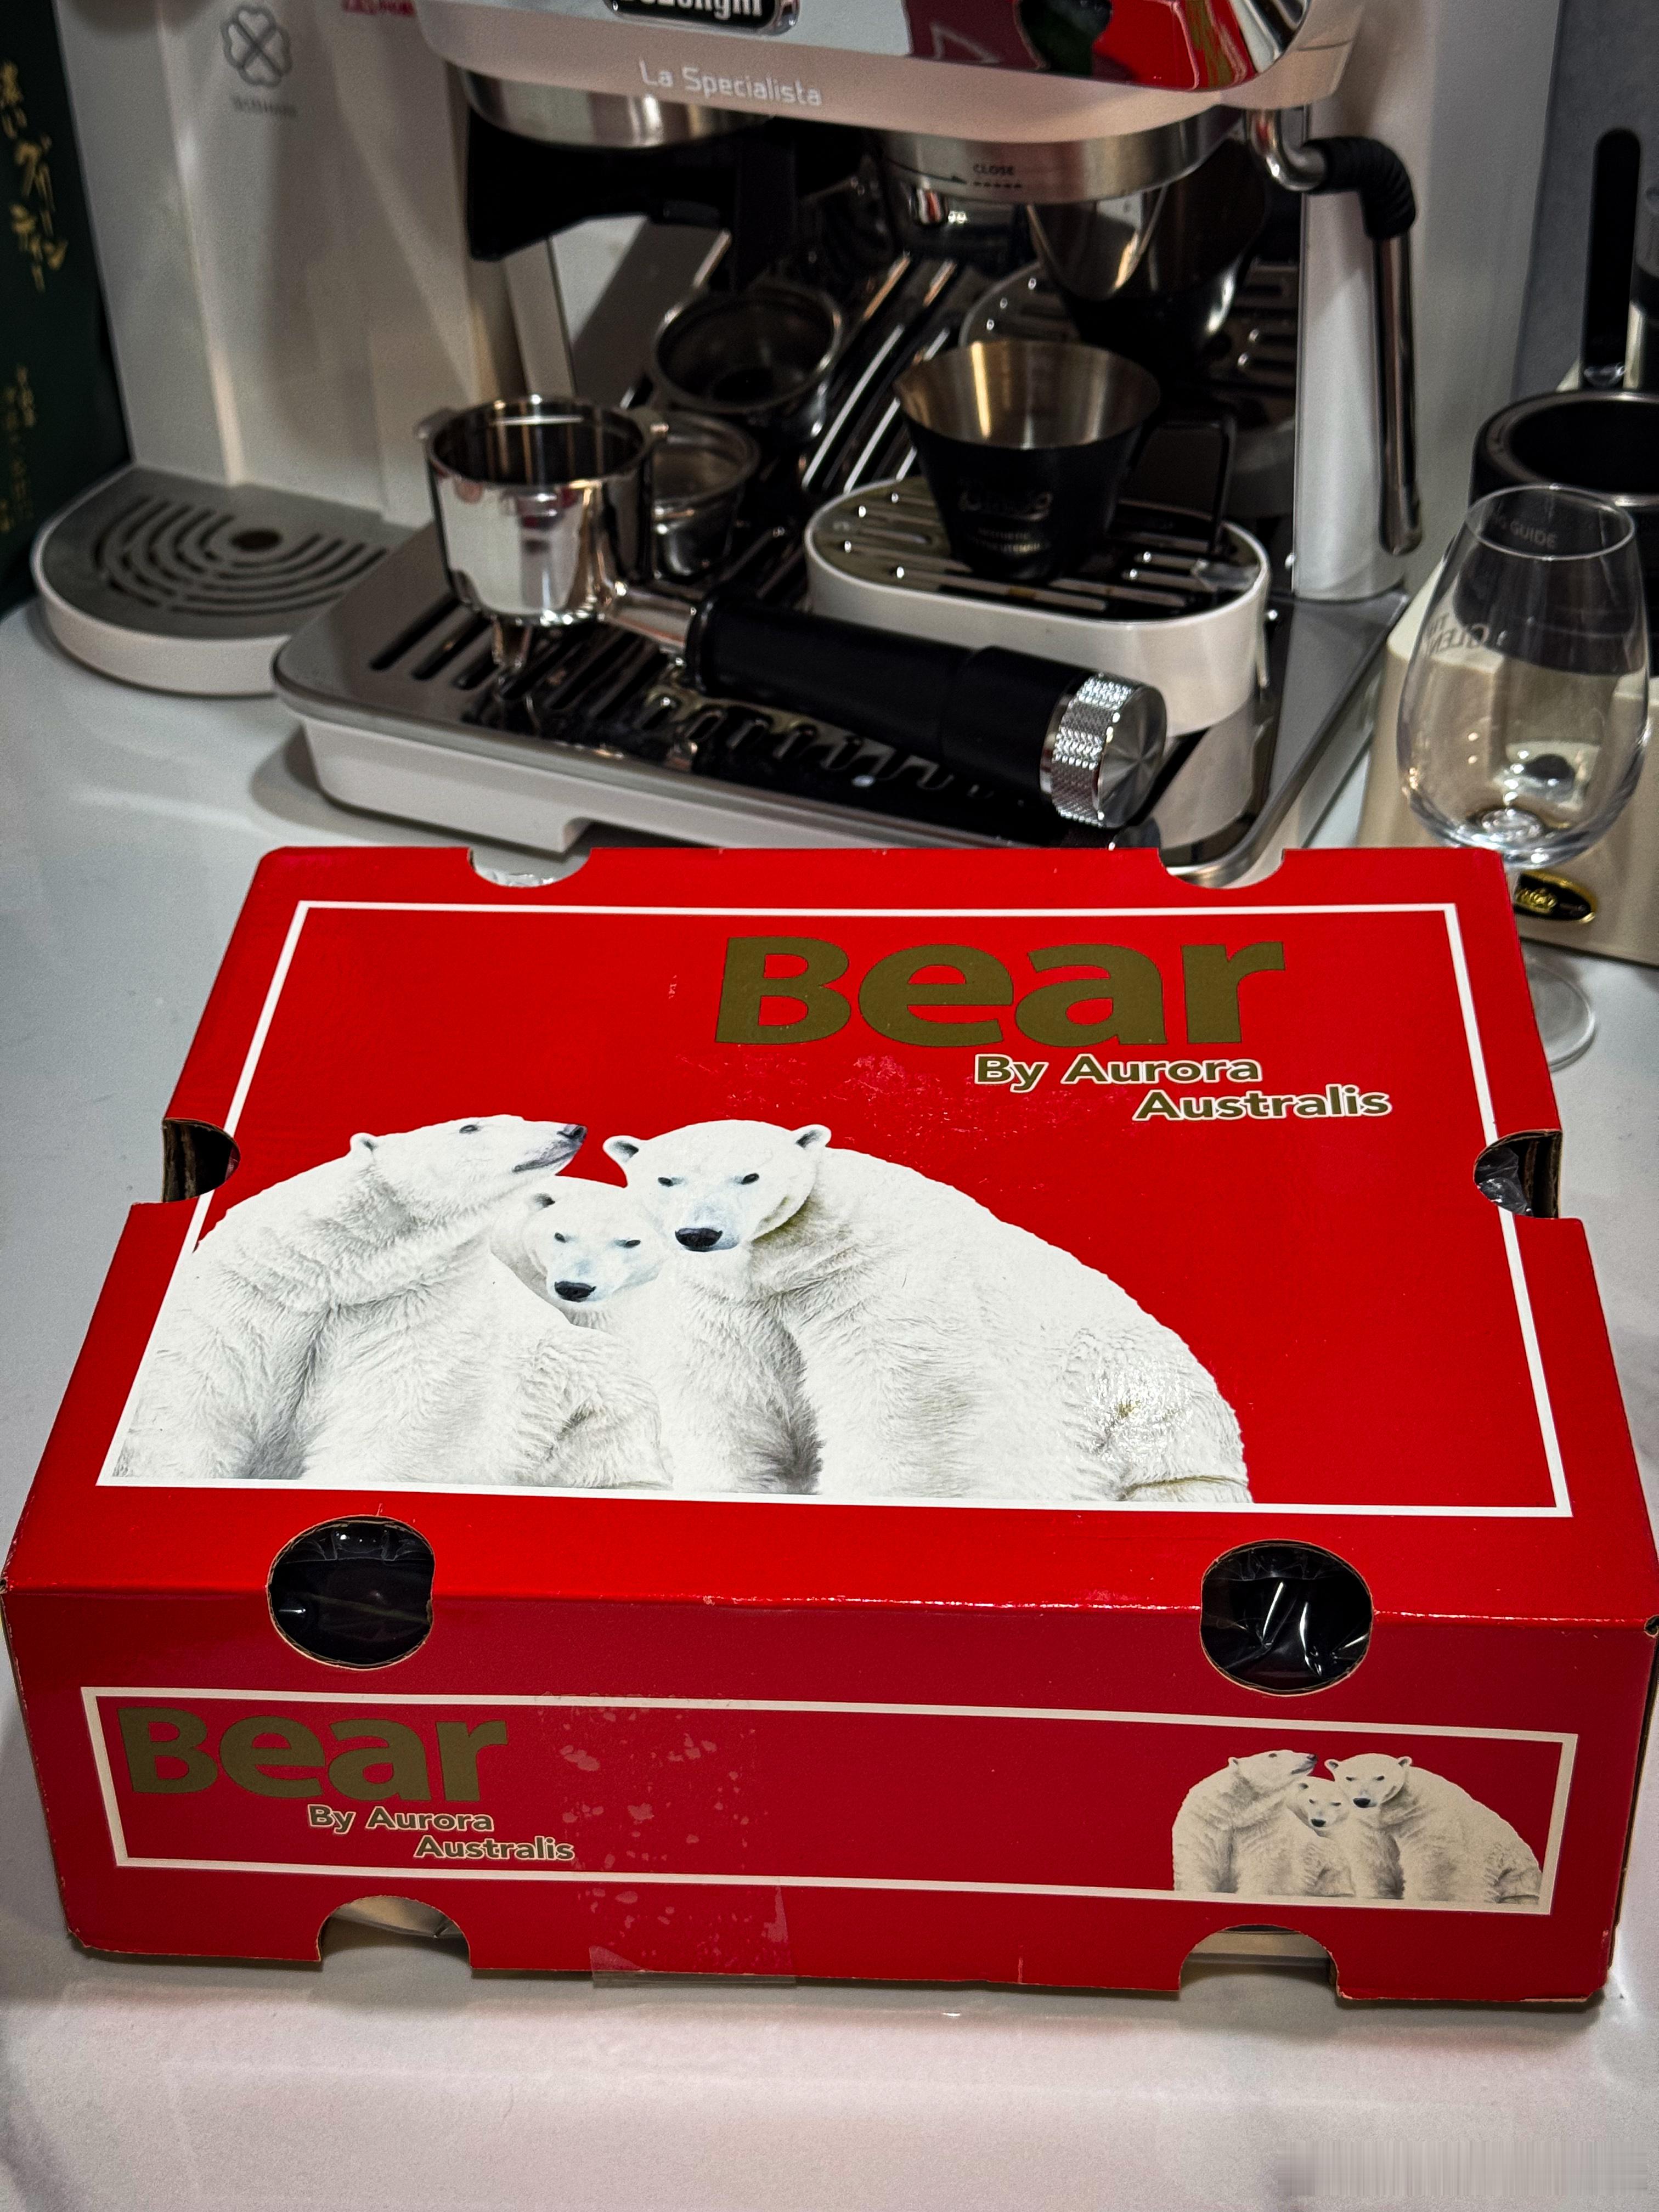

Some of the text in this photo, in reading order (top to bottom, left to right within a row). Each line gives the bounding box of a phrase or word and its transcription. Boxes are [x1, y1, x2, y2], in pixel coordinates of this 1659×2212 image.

[639, 59, 822, 106] La Specialista
[973, 163, 1014, 176] CLOSE
[714, 935, 1286, 1048] Bear
[974, 1053, 1262, 1093] By Aurora
[1132, 1084, 1393, 1121] Australis
[117, 1707, 508, 1802] Bear
[307, 1804, 495, 1835] By Aurora
[413, 1835, 575, 1861] Australis
